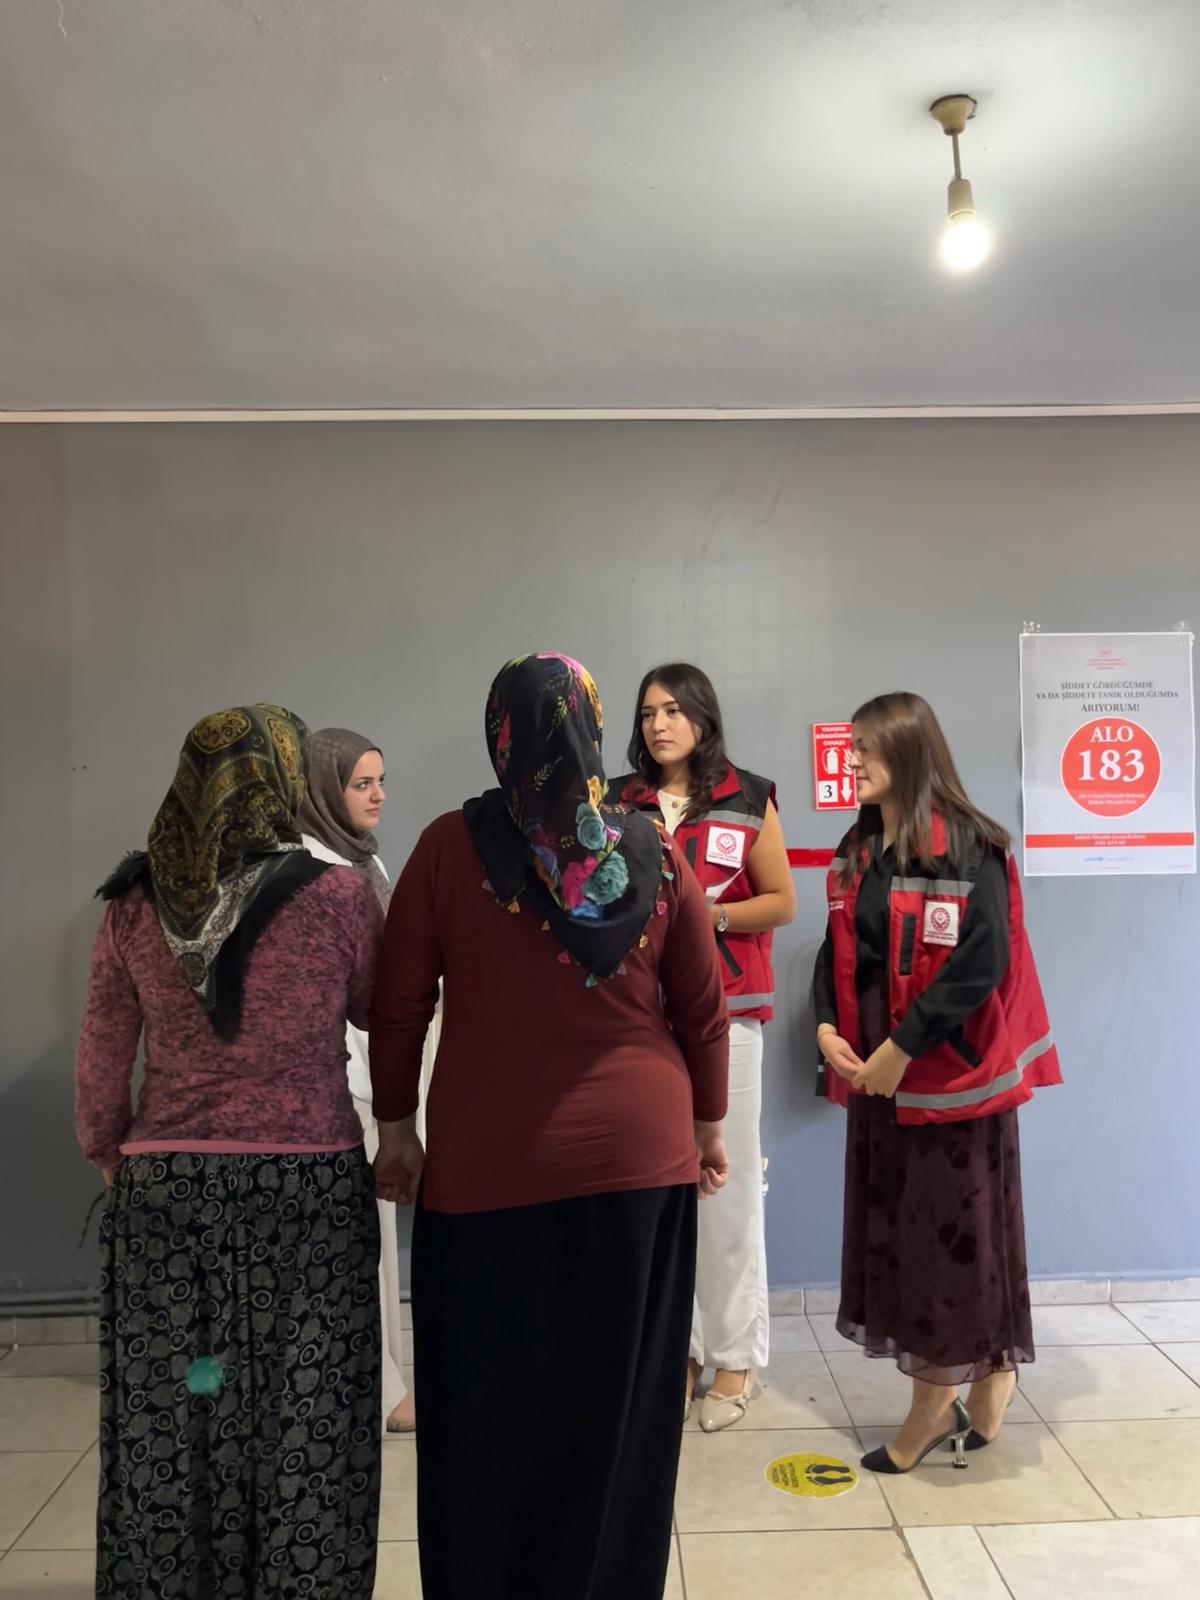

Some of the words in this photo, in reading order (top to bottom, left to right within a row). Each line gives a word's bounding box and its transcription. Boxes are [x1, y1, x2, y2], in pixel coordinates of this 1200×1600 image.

[1061, 682, 1091, 690] ŞİDDET
[1036, 692, 1046, 700] YA
[1061, 691, 1096, 700] ŞİDDETE
[1081, 703, 1140, 712] ARIYORUM!
[1090, 726, 1133, 742] ALO
[1078, 749, 1145, 782] 183
[823, 785, 833, 799] 3
